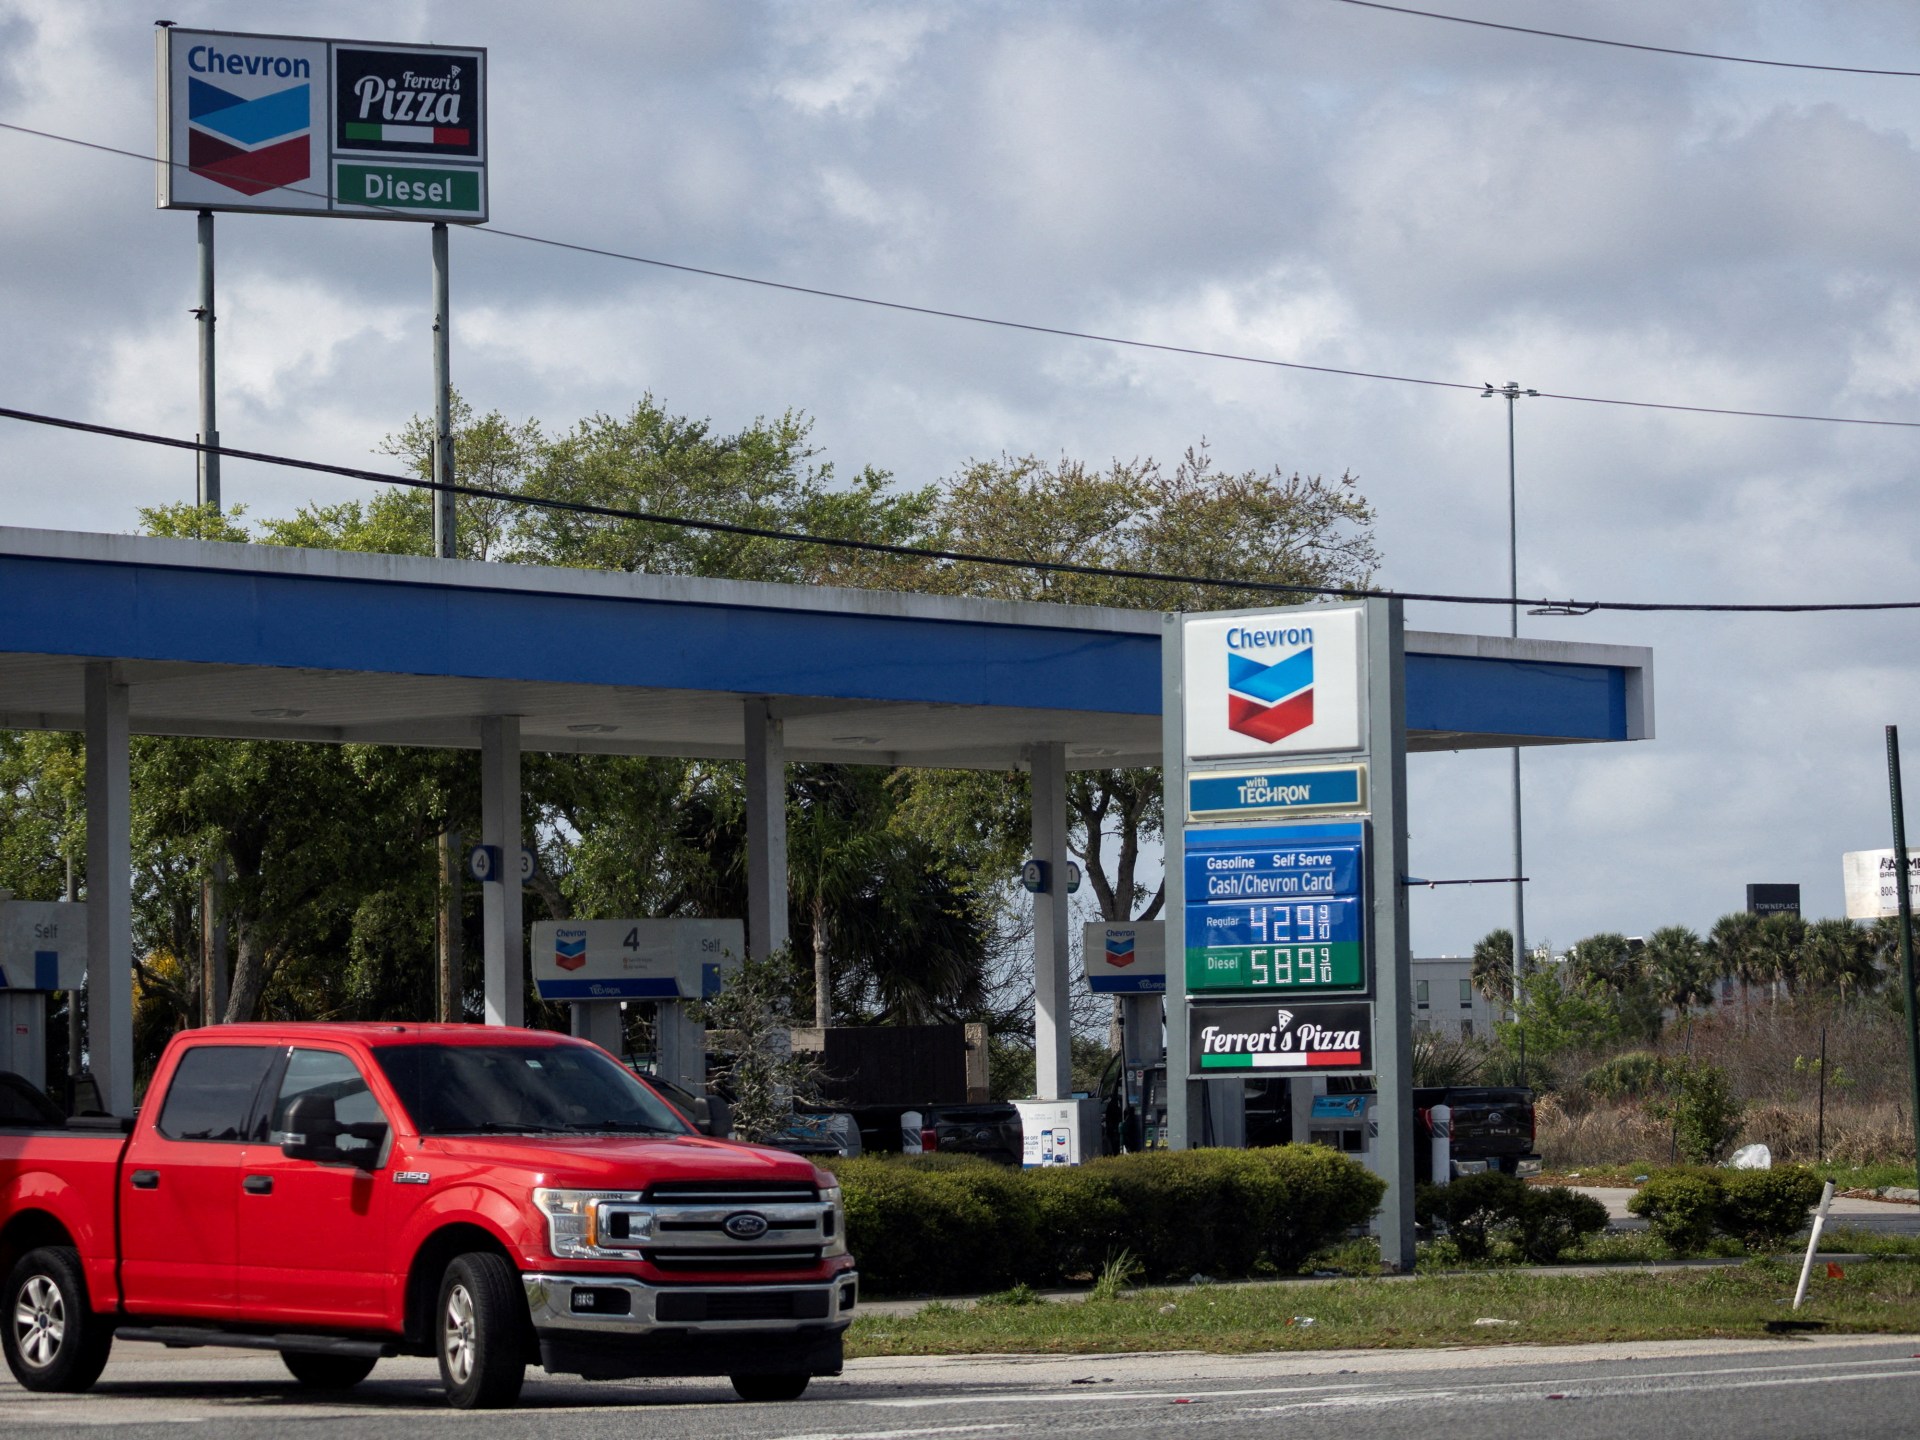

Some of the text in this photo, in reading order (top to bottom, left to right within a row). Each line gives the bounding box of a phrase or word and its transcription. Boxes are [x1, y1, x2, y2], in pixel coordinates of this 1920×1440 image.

[188, 45, 310, 79] Chevron
[402, 66, 461, 92] Ferreri's
[354, 75, 461, 124] Pizza
[365, 173, 452, 203] Diesel
[1227, 627, 1313, 649] Chevron
[1246, 777, 1268, 788] with
[1238, 785, 1309, 805] TECHRON
[476, 855, 486, 871] 4
[521, 856, 529, 872] 3
[1207, 853, 1333, 870] Gasoline Self Serve
[1029, 868, 1037, 880] 2
[1068, 869, 1074, 881] 1
[1208, 872, 1333, 895] Cash/Chevron Card
[34, 923, 58, 939] Self
[1106, 929, 1136, 937] Chevron
[1206, 916, 1240, 929] Regular
[1250, 905, 1314, 941] 429
[556, 927, 720, 953] Chevron 4 Self
[1207, 956, 1239, 970] Diesel
[1251, 948, 1315, 984] 589
[1201, 1012, 1360, 1053] Ferreri's Pizza
